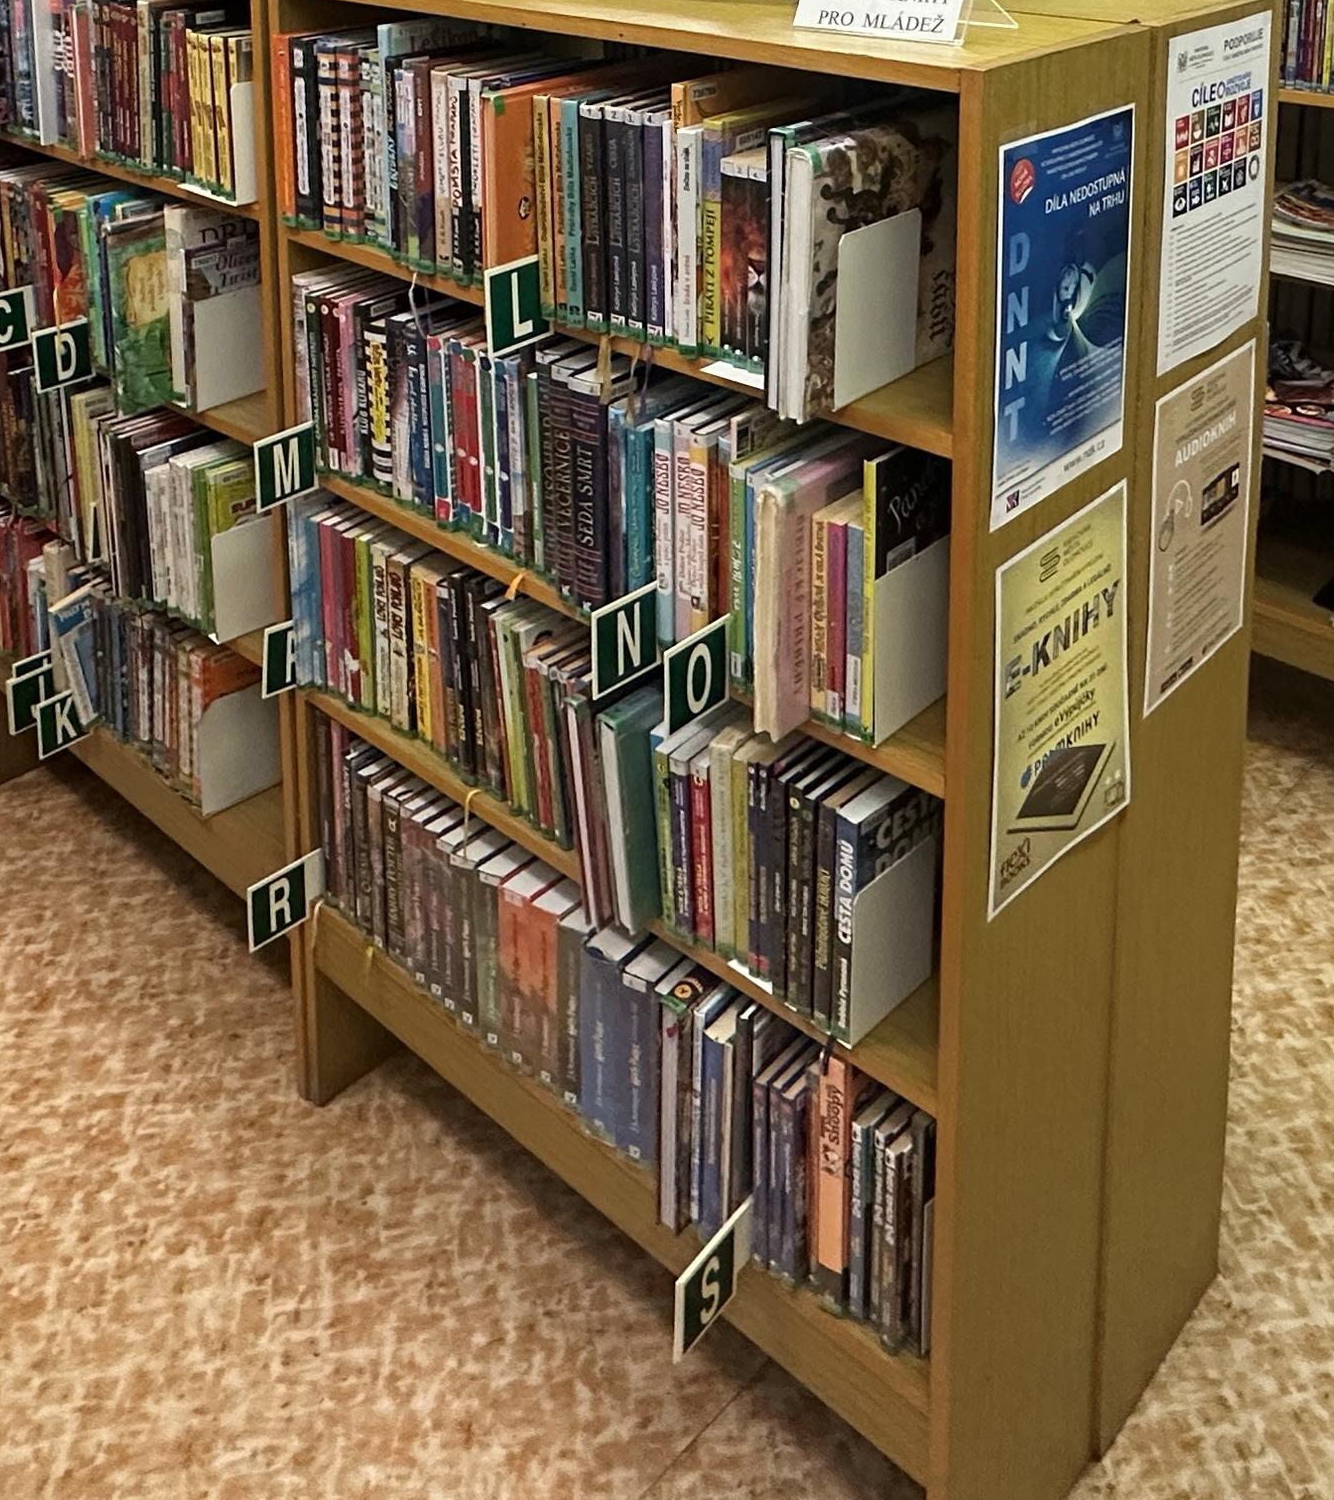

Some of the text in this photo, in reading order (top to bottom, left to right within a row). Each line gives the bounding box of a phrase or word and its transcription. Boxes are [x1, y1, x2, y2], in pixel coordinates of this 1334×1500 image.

[817, 9, 946, 34] PRO MLÁDEŽ
[1045, 167, 1126, 214] DÍLA NEDOSTUPNÁ
[1089, 190, 1125, 217] NA TRHU
[510, 271, 534, 340] L
[704, 280, 715, 324] PIRÁTI
[55, 332, 78, 381] D
[1175, 410, 1236, 468] AUDIOKNIH
[274, 441, 300, 495] M
[576, 445, 594, 496] SMRT
[616, 608, 642, 676] N
[1004, 578, 1122, 700] E-KNIHY
[687, 641, 712, 714] O
[55, 704, 79, 744] K
[838, 840, 854, 893] DOMŮ
[269, 875, 292, 932] R
[838, 896, 852, 944] CESTA
[698, 1259, 720, 1324] S
